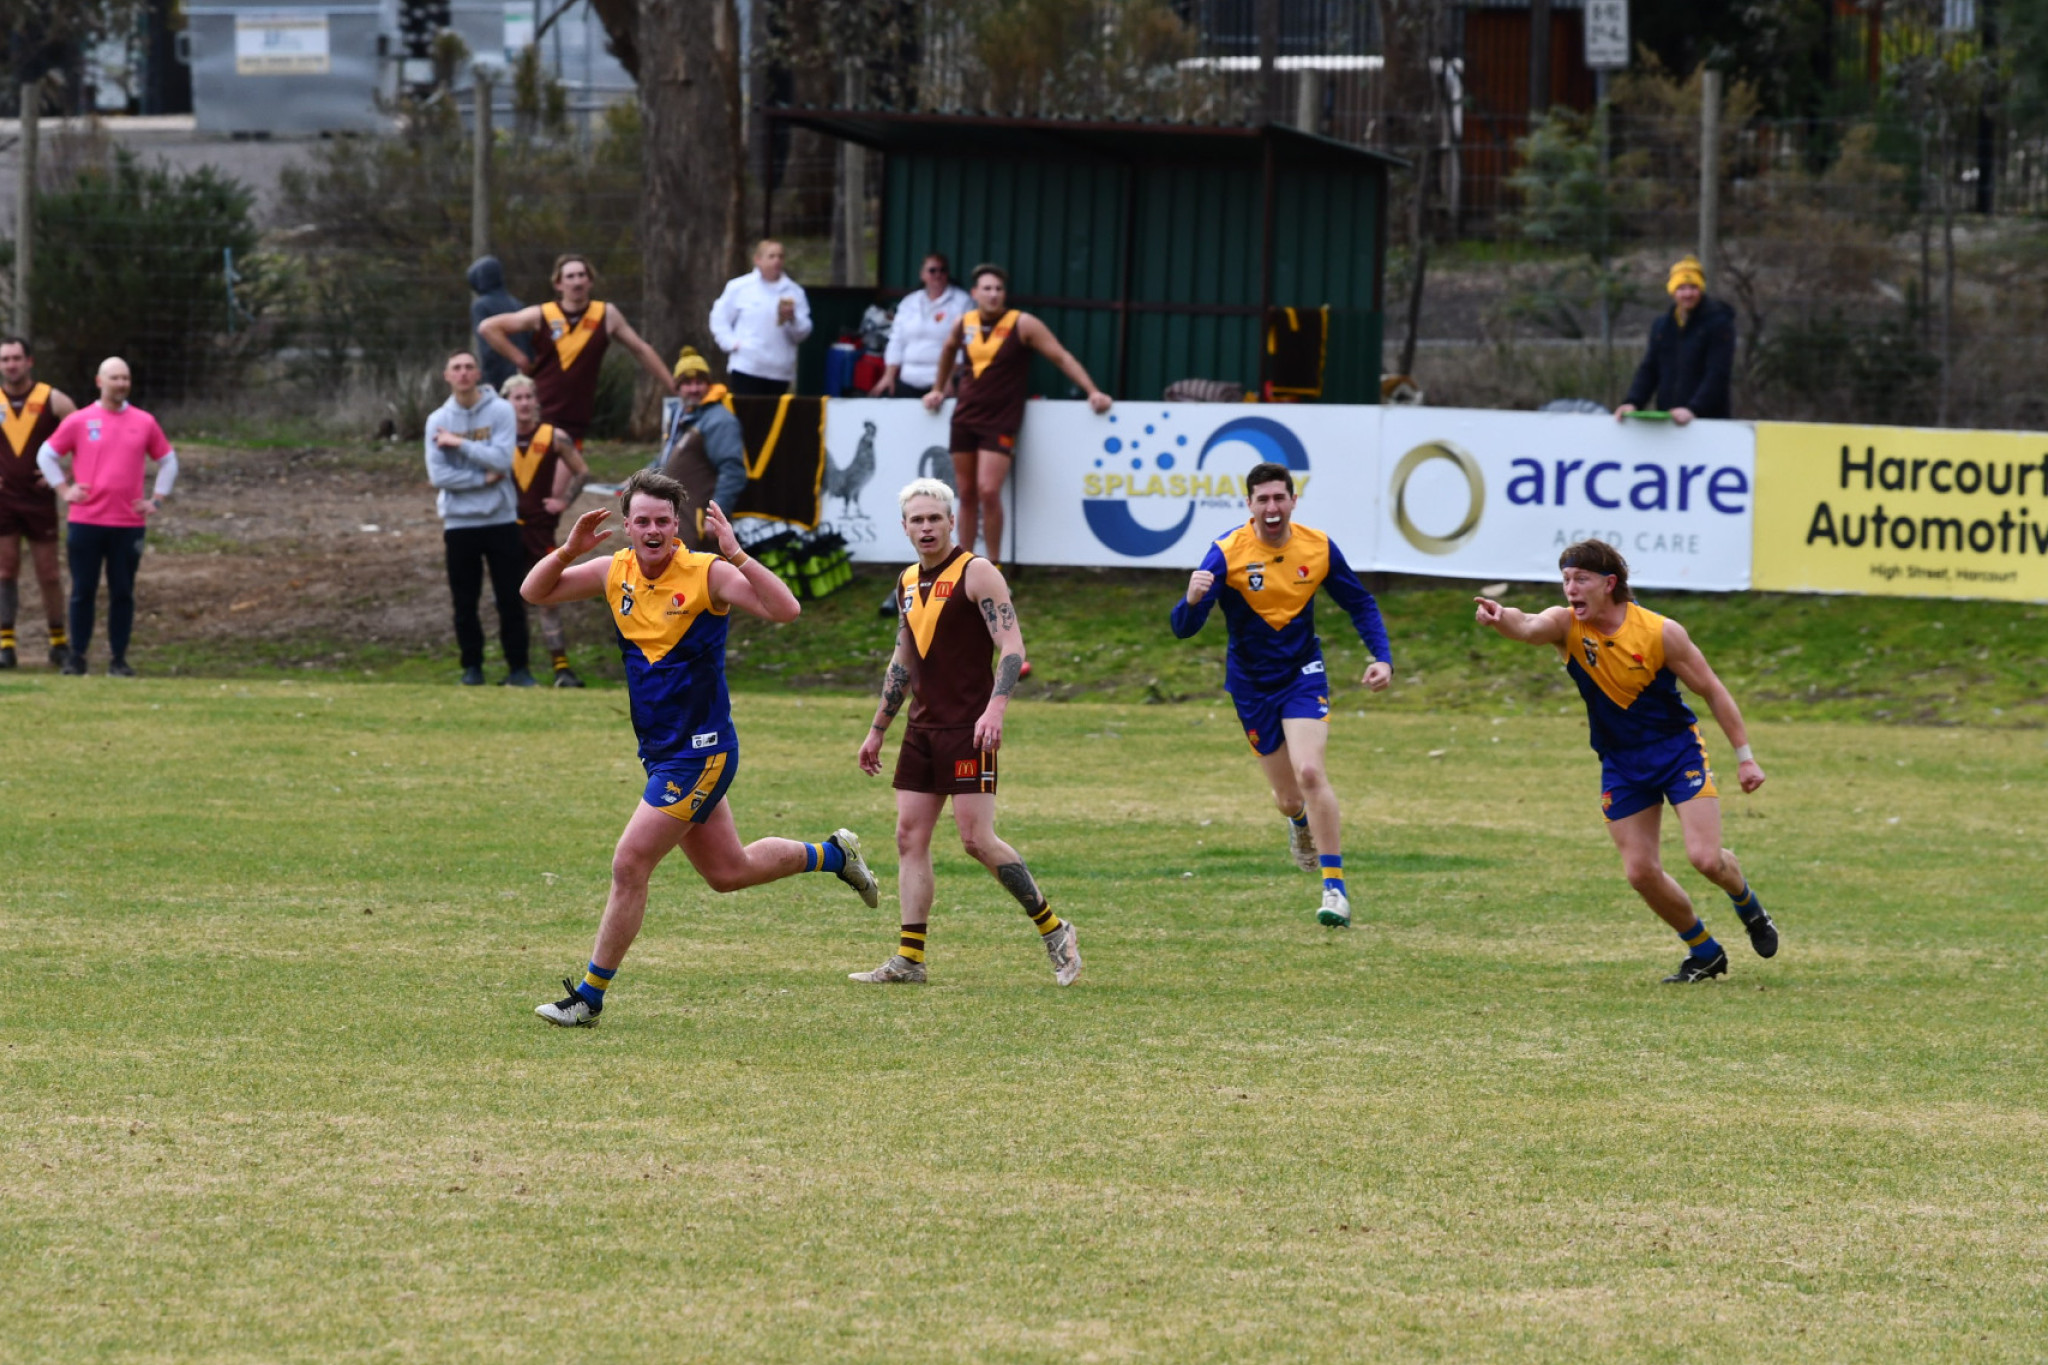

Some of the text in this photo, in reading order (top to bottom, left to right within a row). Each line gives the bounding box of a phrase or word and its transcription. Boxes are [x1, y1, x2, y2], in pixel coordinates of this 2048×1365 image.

[1841, 445, 2048, 497] Harcourt
[1083, 473, 1311, 498] SPLASHAY
[1506, 458, 1749, 514] arcare
[1634, 532, 1699, 554] CARE
[1870, 564, 1901, 580] High
[1956, 570, 2018, 582] Harcourt
